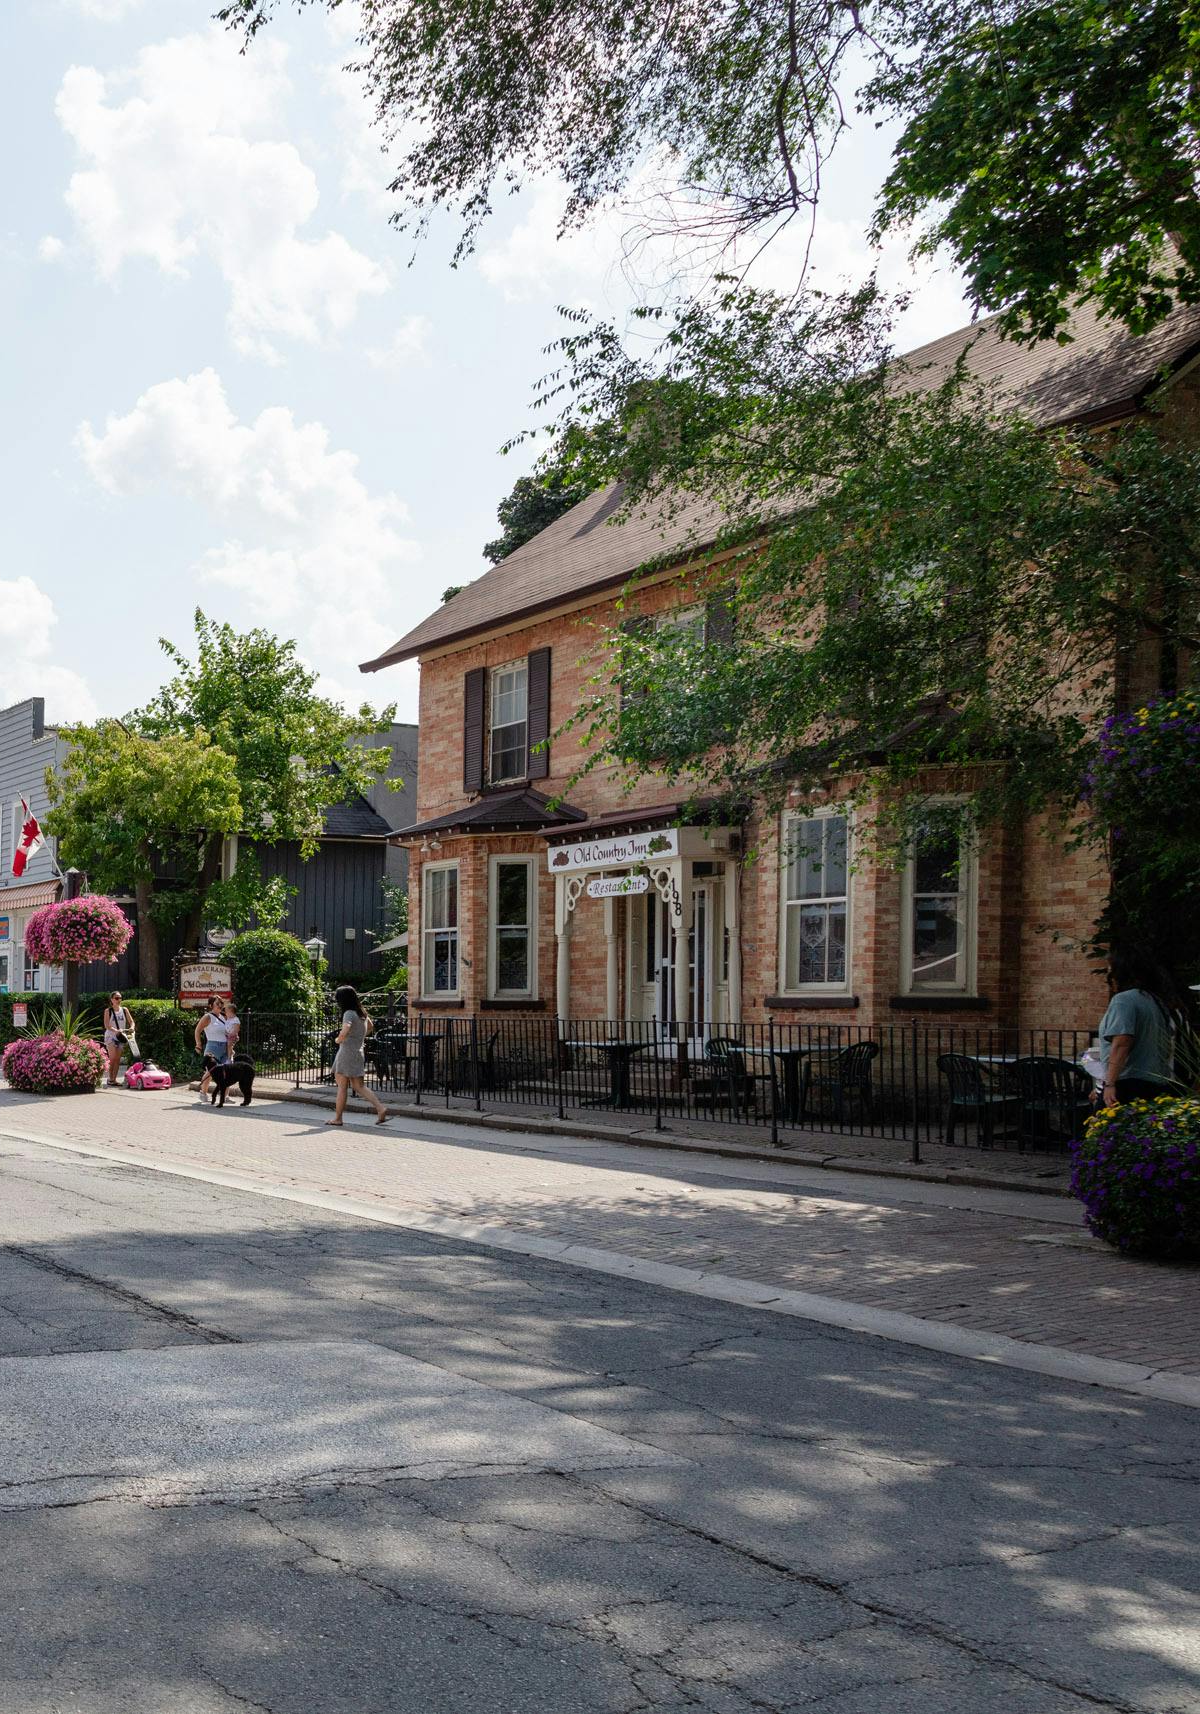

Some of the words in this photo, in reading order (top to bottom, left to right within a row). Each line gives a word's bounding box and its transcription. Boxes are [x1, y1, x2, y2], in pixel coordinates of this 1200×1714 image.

[574, 848, 590, 863] Old
[593, 845, 626, 861] Country
[628, 840, 646, 855] Inn
[670, 878, 681, 916] 198
[183, 966, 229, 975] RESTAURANT
[184, 981, 195, 989] Old
[196, 980, 216, 992] Country
[217, 980, 228, 988] Inn
